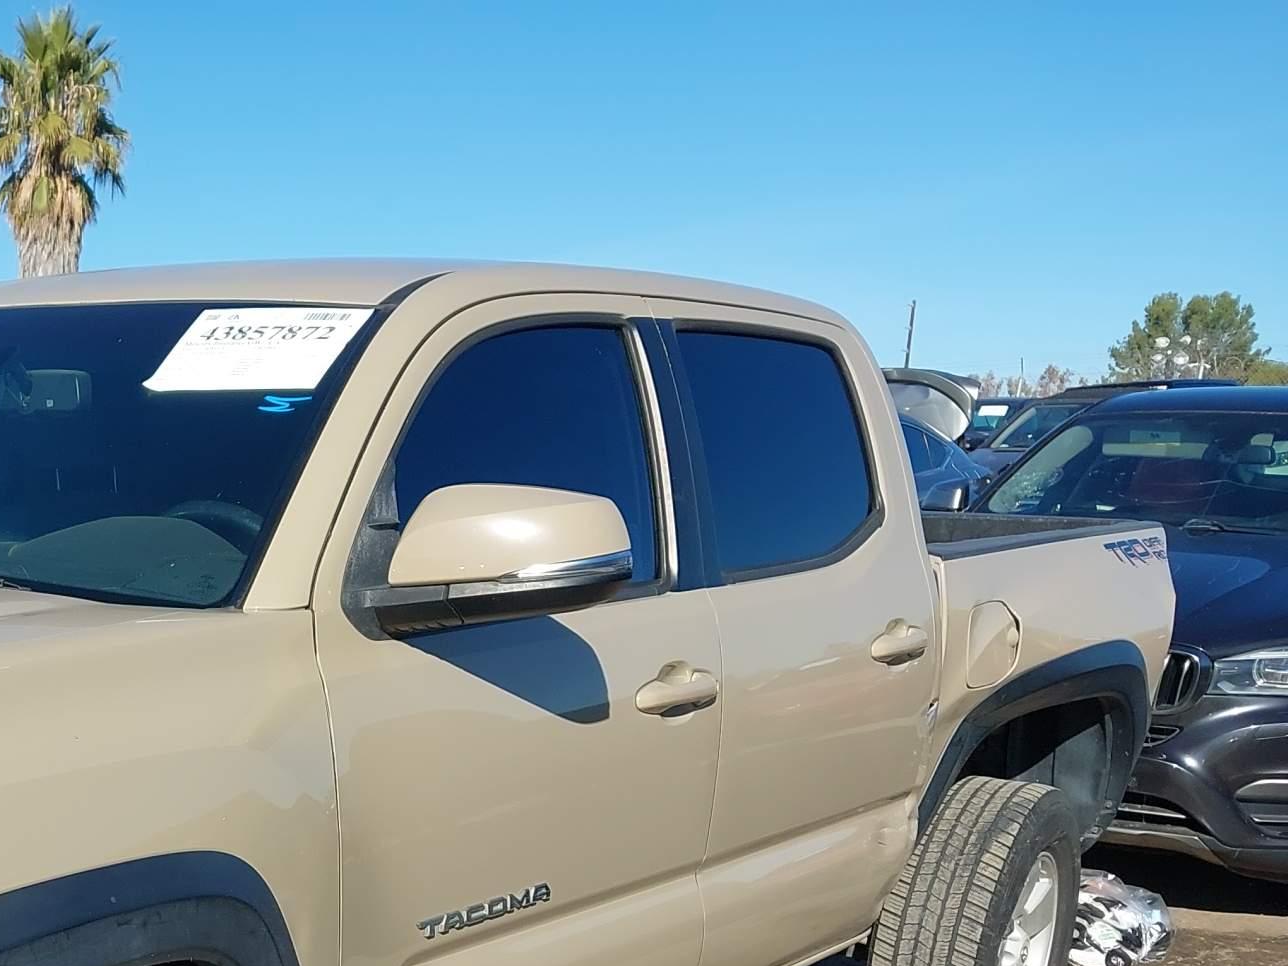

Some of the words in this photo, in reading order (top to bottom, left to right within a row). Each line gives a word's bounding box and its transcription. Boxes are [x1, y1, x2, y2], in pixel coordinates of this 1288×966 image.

[200, 326, 336, 341] 43857872
[1103, 539, 1149, 566] TRD
[416, 883, 552, 940] TACOMA
